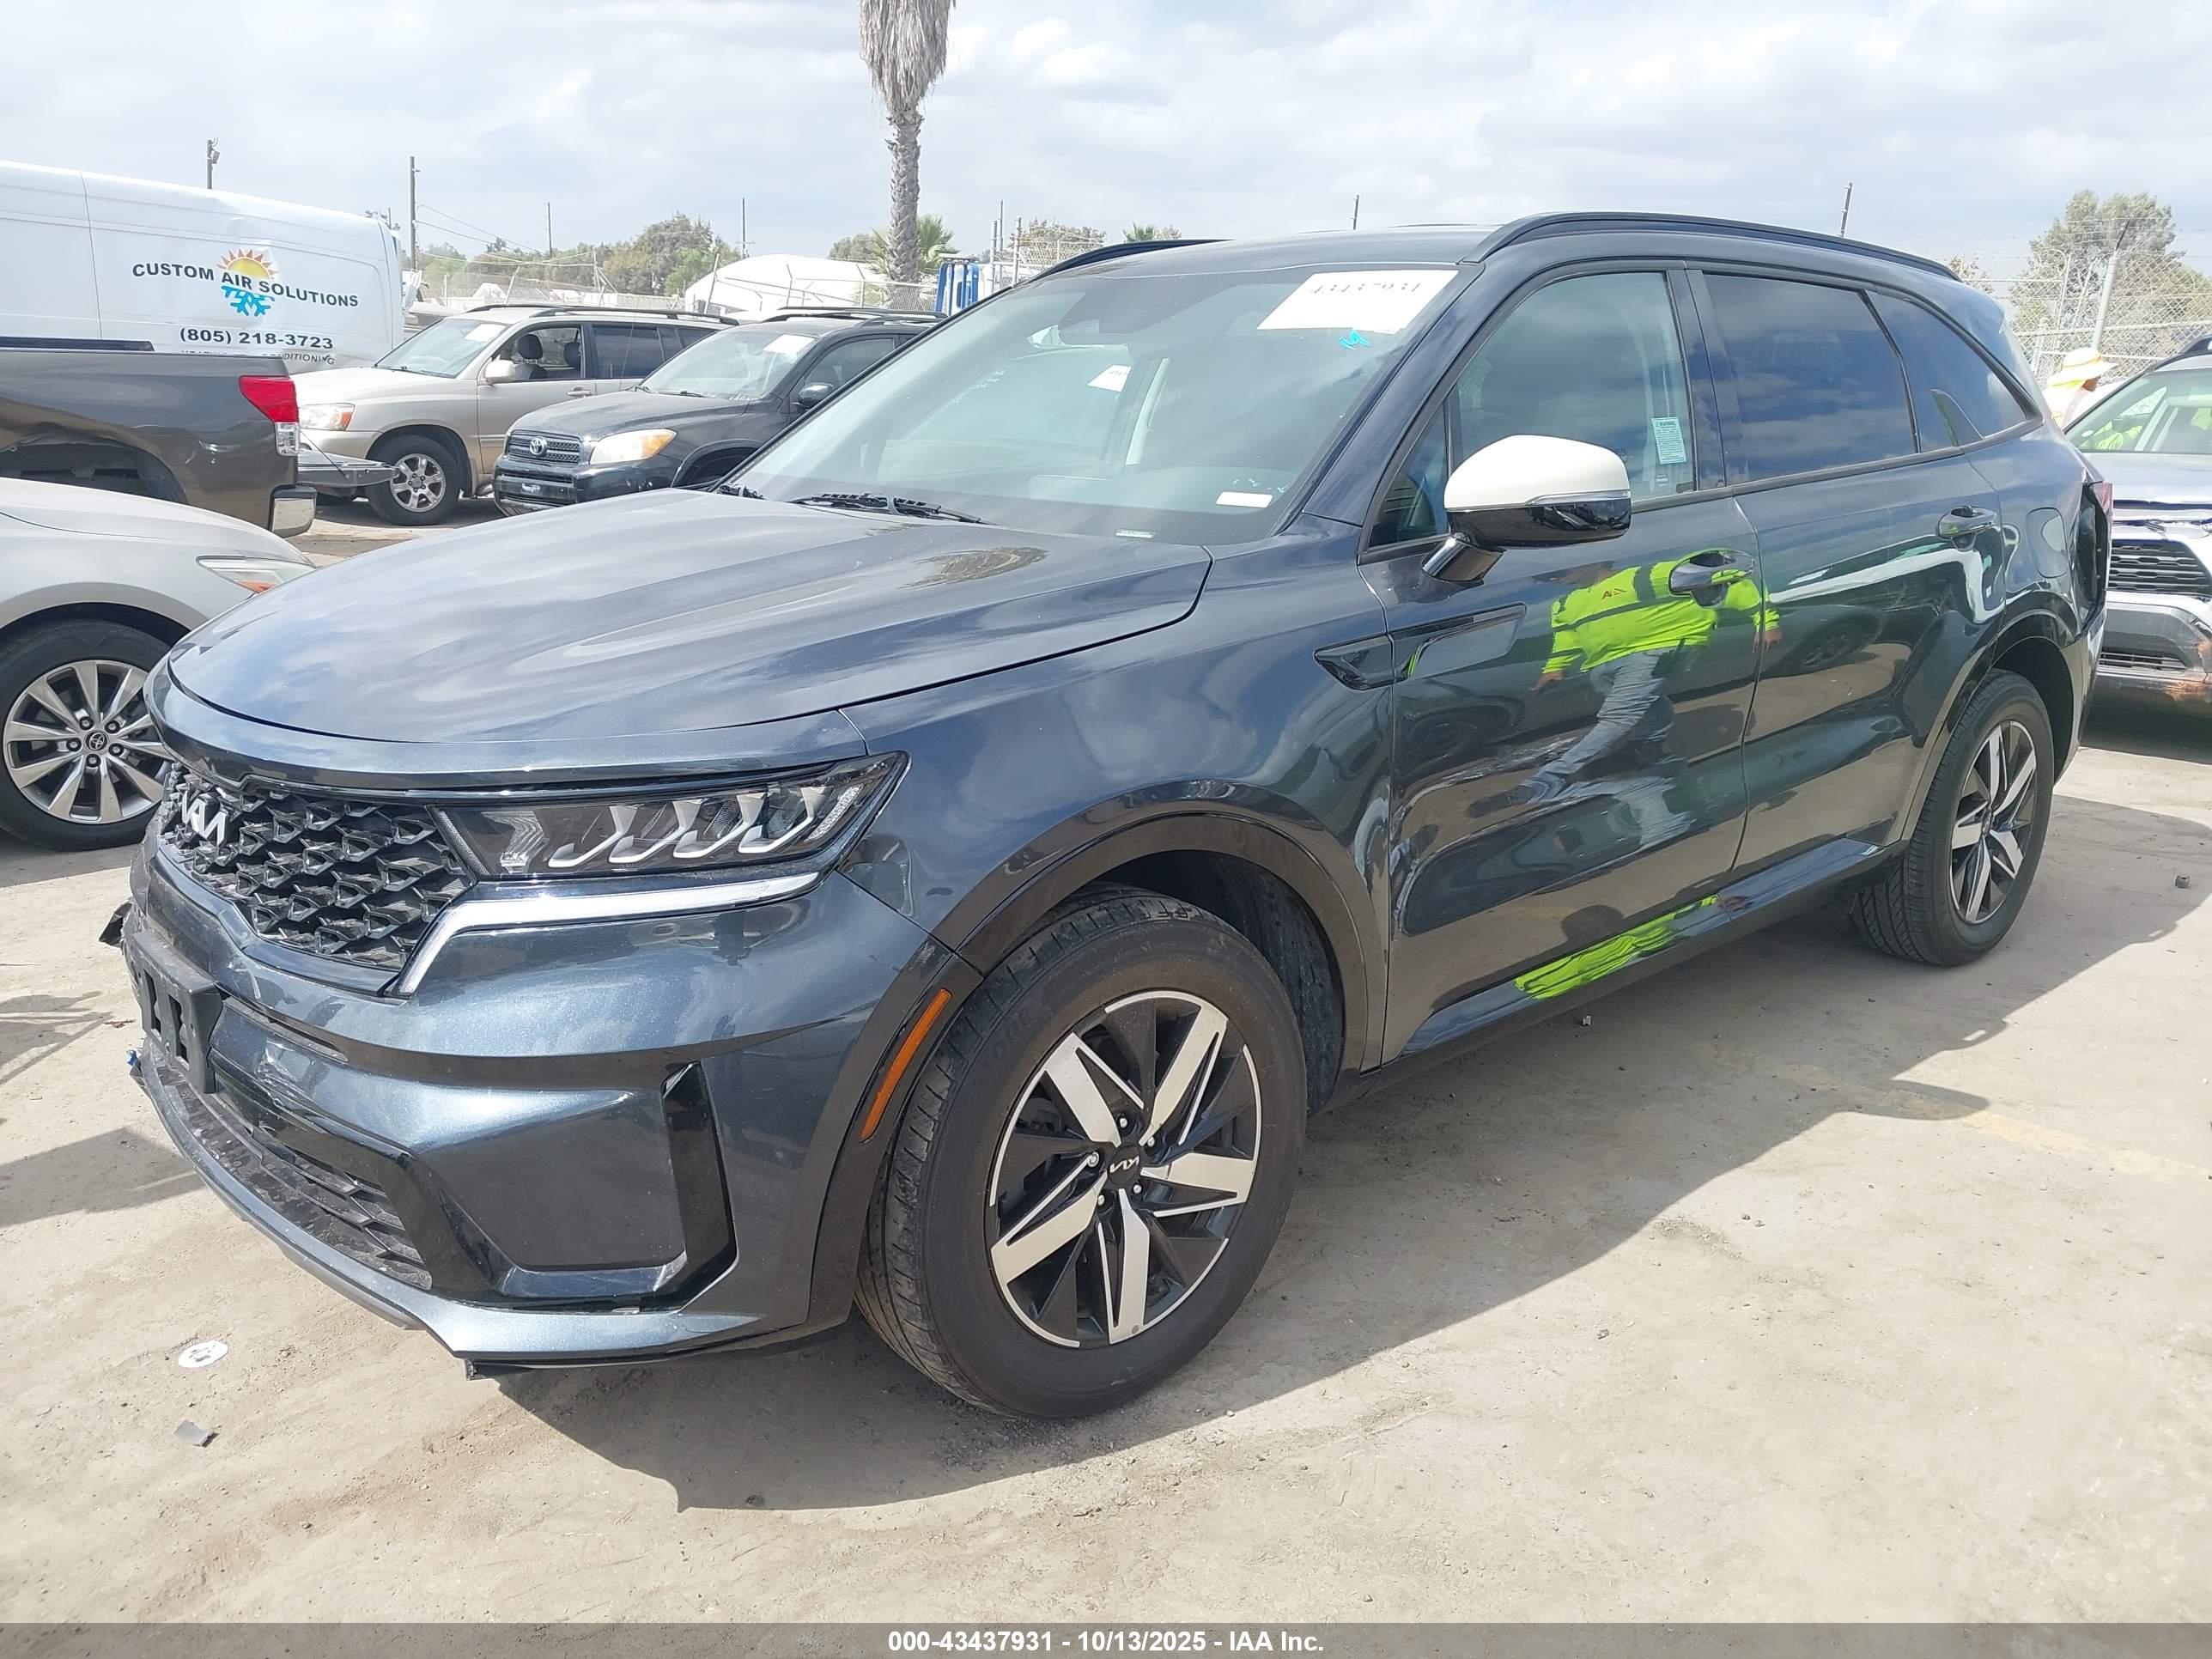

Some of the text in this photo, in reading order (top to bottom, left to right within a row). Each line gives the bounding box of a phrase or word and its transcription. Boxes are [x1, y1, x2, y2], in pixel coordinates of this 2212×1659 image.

[132, 263, 359, 307] CUSTOM AIR SOLUTIONS
[180, 327, 333, 349] (805) 218-3723
